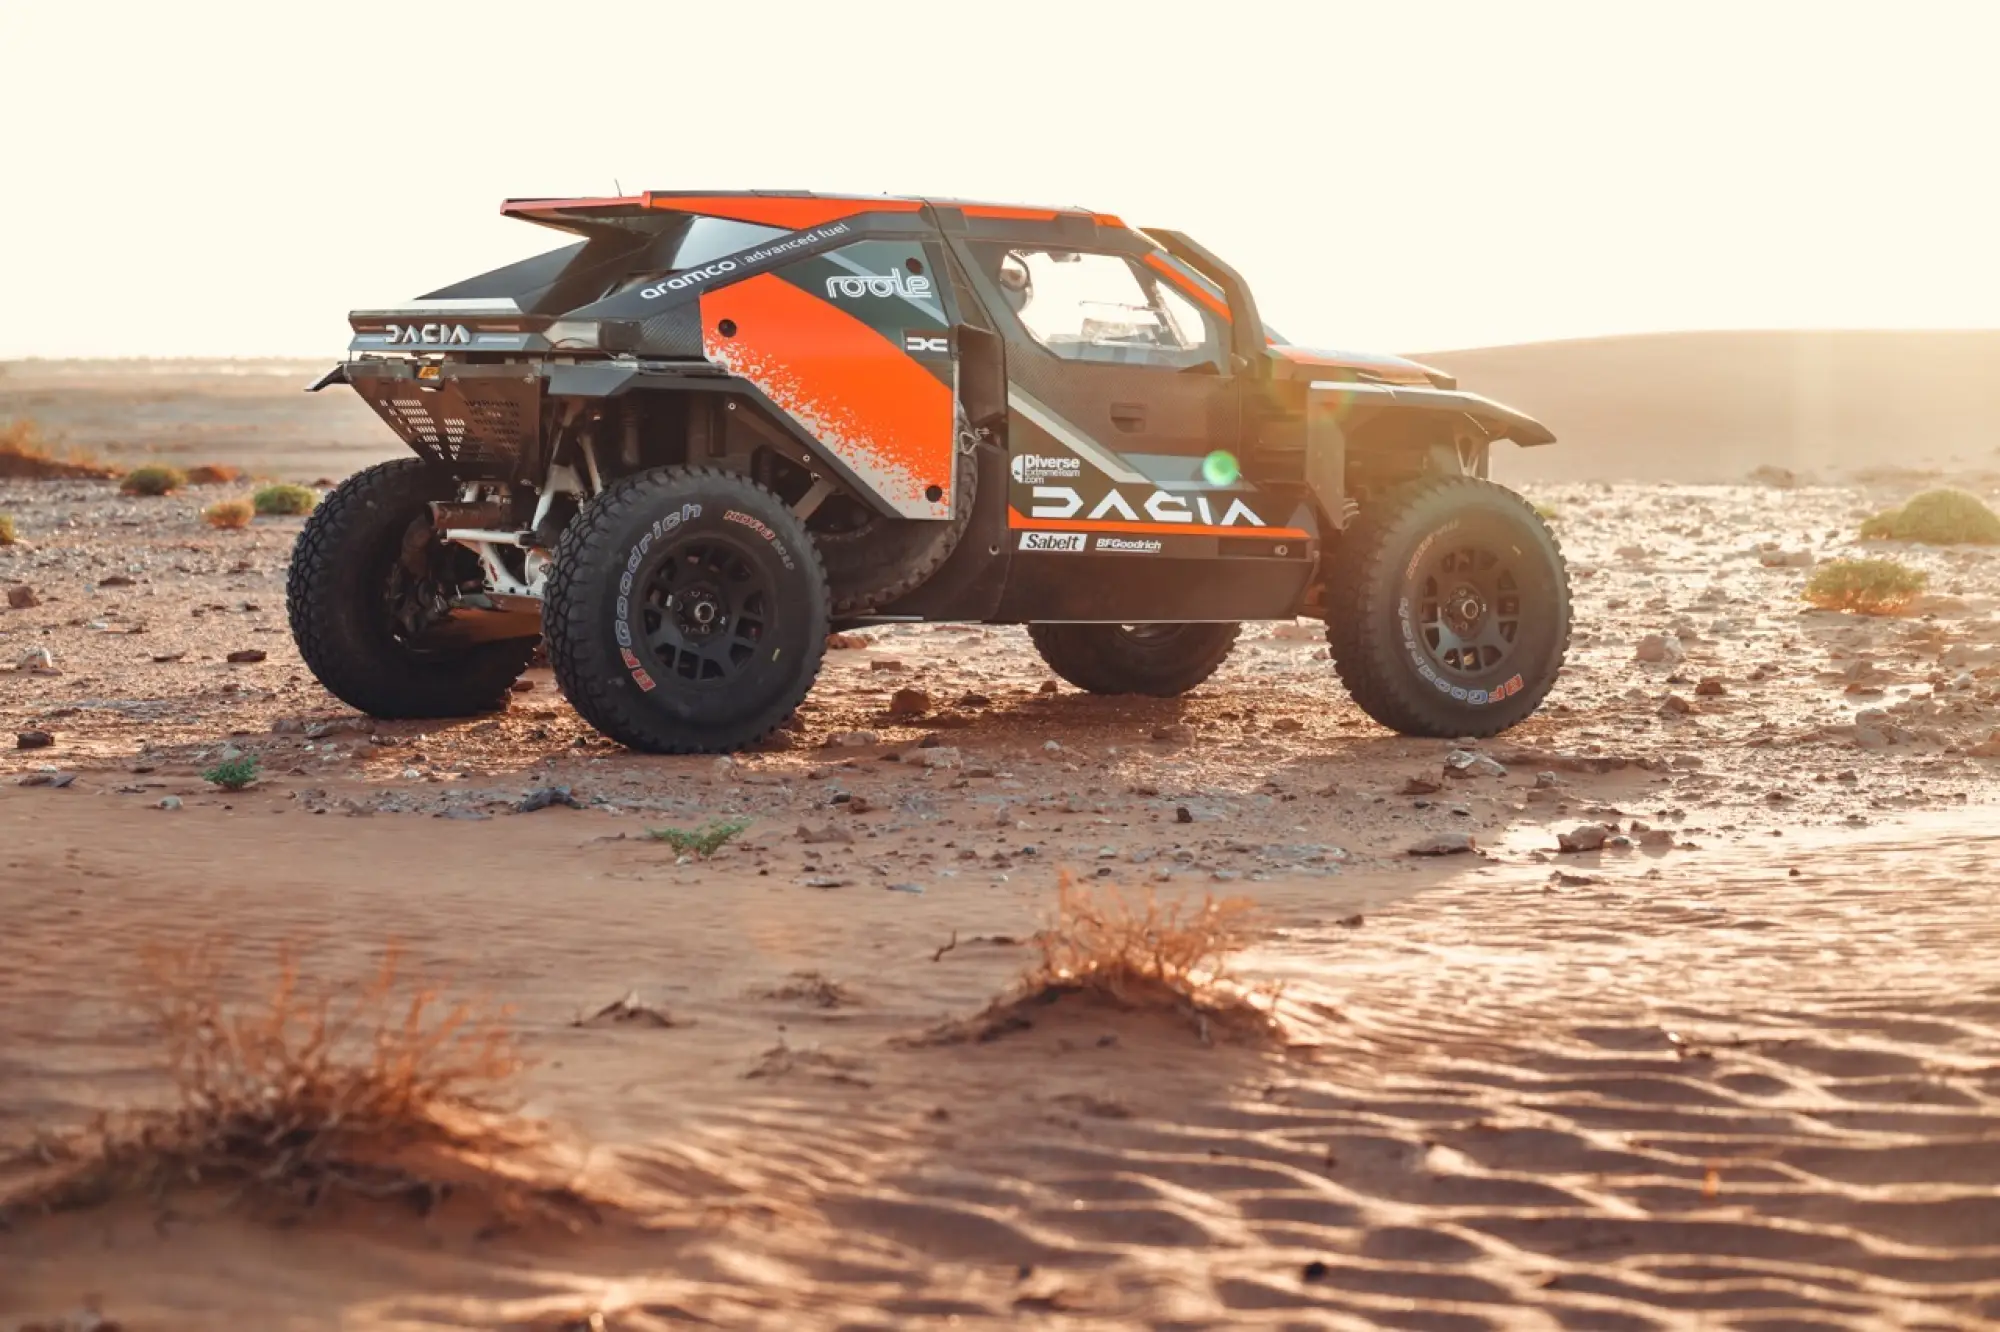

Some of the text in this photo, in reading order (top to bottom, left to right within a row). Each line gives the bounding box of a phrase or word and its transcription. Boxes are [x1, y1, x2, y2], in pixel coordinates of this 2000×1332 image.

[639, 221, 850, 300] aramco advanced fuel
[384, 324, 472, 343] DACIA
[1024, 454, 1080, 469] Diverse
[1032, 486, 1266, 527] DACIA
[1026, 534, 1080, 550] Sabelt
[1096, 538, 1162, 550] BFGoodrich
[615, 503, 703, 692] BFGoodrich
